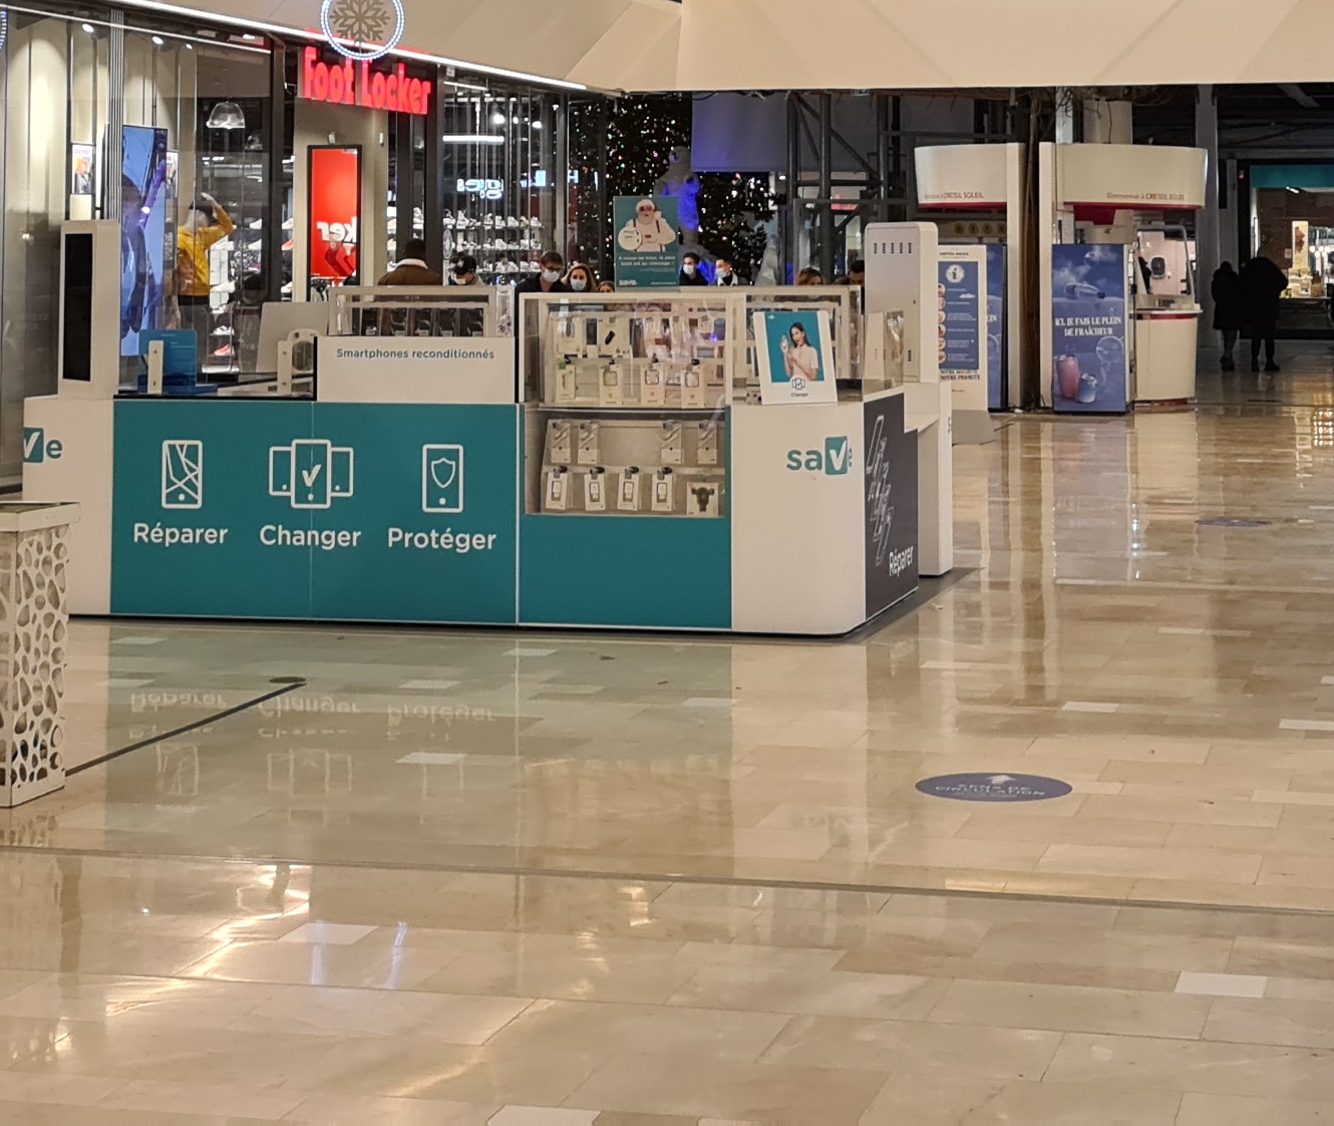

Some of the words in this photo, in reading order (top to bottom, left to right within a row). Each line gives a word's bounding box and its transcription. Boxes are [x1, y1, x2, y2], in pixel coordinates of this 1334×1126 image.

[303, 45, 356, 105] Foot
[360, 59, 432, 115] Locker
[1064, 327, 1074, 336] DE
[1075, 317, 1090, 326] FAIS
[1091, 317, 1100, 325] LE
[1101, 316, 1122, 325] PLEIN
[336, 347, 409, 360] Smartphones
[411, 347, 495, 360] reconditionnés
[133, 522, 229, 547] Réparer
[259, 524, 362, 550] Changer
[387, 527, 497, 553] Protéger
[889, 545, 914, 577] Réparer
